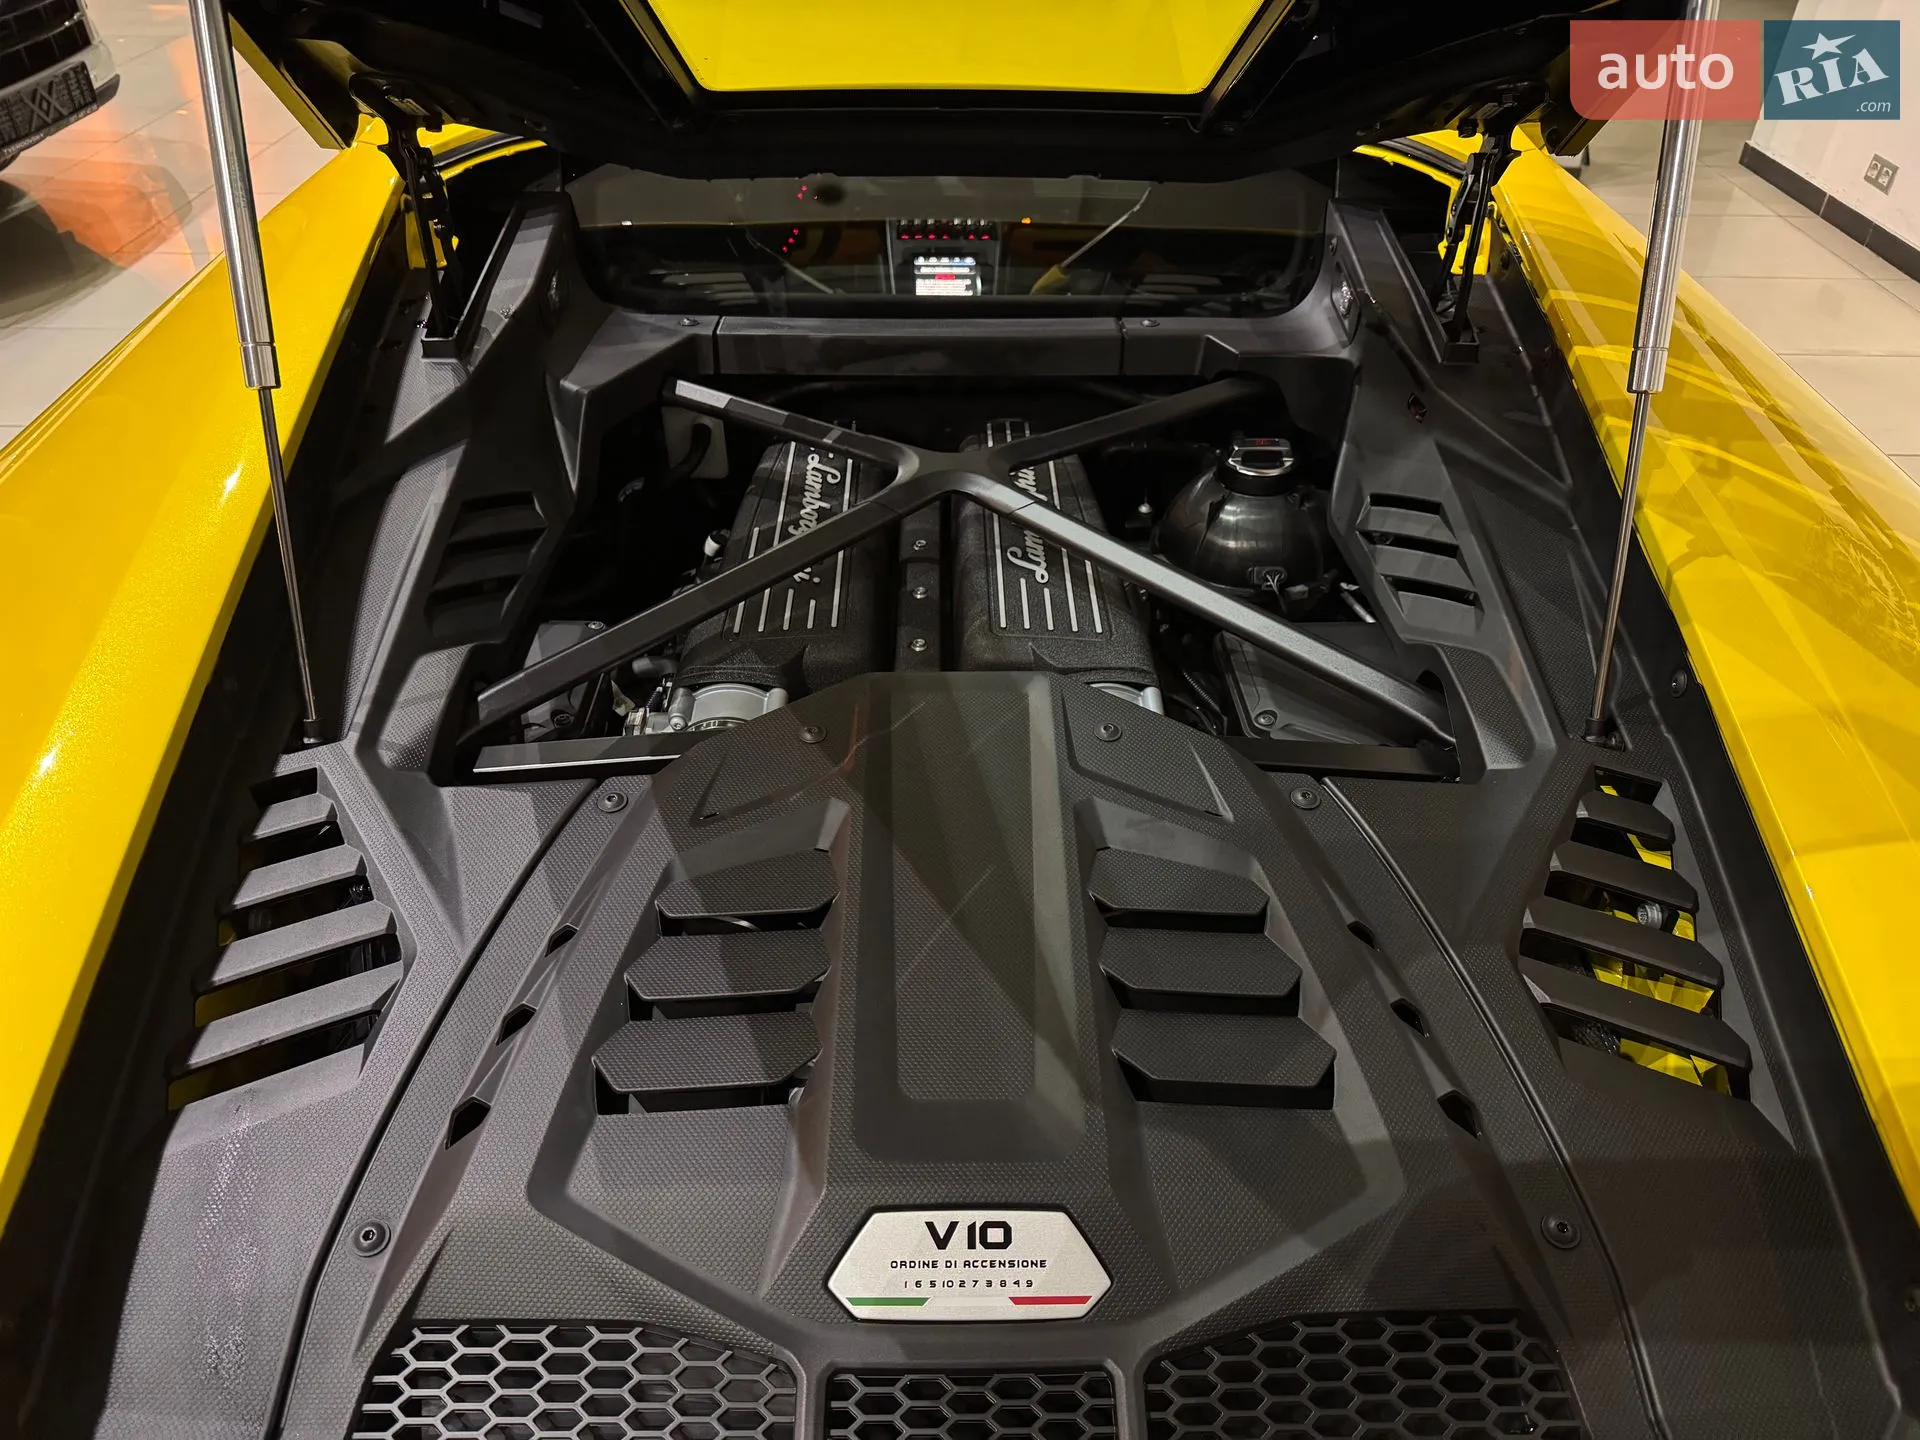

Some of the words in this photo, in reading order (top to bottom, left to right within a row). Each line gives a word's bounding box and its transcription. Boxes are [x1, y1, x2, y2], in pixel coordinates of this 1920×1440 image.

[890, 1259, 939, 1269] ORDINE
[944, 1259, 958, 1269] DI
[963, 1259, 1048, 1269] ACCENSIONE
